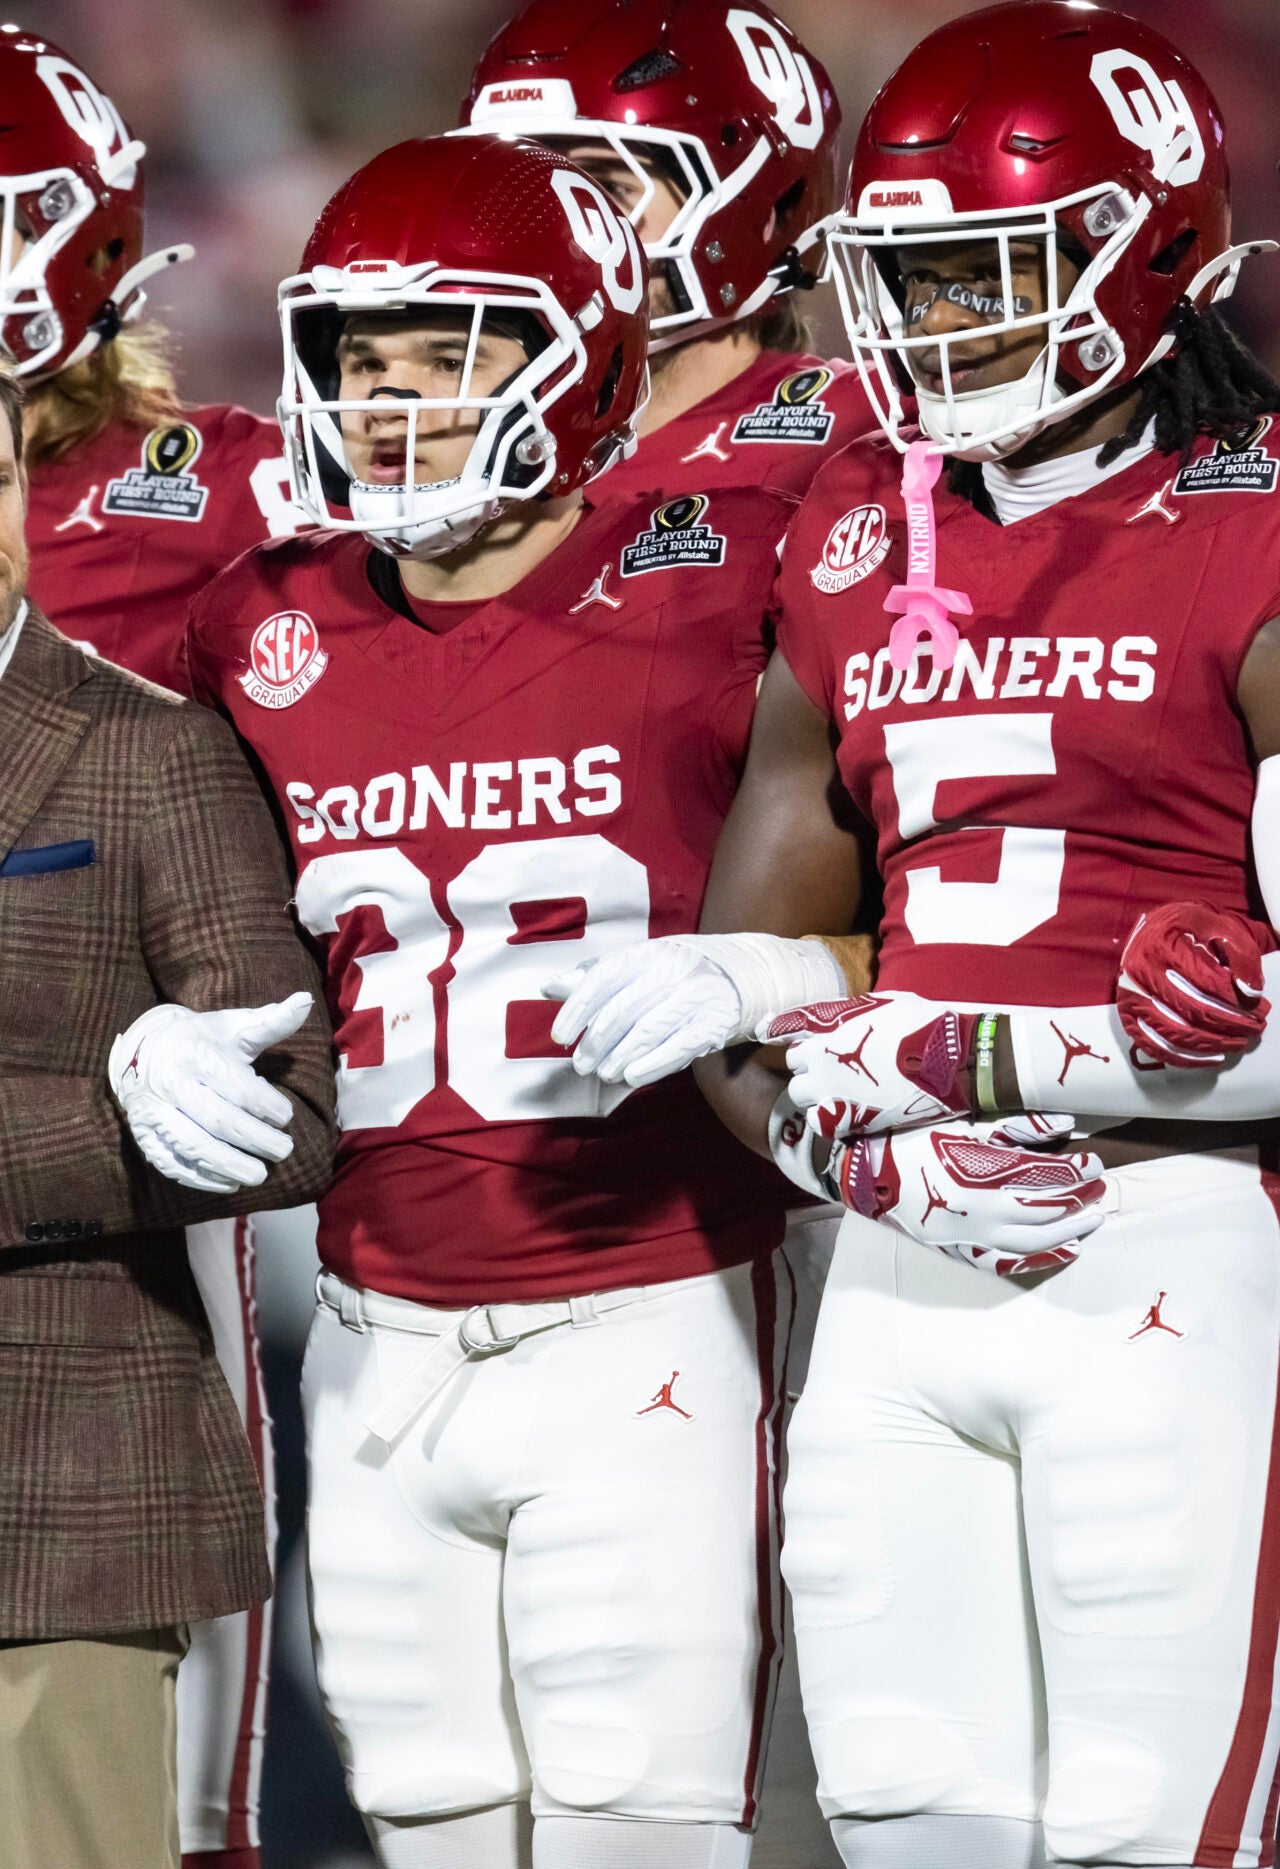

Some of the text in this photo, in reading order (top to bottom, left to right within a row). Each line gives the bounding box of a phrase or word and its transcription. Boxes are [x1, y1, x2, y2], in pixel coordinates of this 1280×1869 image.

[1089, 48, 1206, 187] OU
[869, 191, 923, 207] OKLAHOMA
[550, 168, 643, 314] OU
[948, 283, 1025, 313] CONTRL
[741, 416, 828, 428] FIRST ROUND
[759, 405, 817, 417] PLAYOFF
[1182, 463, 1272, 479] FIRST ROUND
[1200, 452, 1259, 467] PLAYOFF
[627, 539, 719, 560] FIRST ROUND
[641, 529, 704, 546] PLAYOFF
[677, 551, 710, 560] Allstate
[828, 509, 880, 568] SEC
[910, 503, 930, 574] NXTRND
[817, 554, 881, 591] GRADUATE
[257, 616, 310, 683] SEC
[250, 669, 316, 707] GRADUATE
[843, 636, 1157, 721] SOONERS
[286, 744, 621, 843] SOONERS
[883, 713, 1066, 947] 5
[296, 834, 650, 1130] 38
